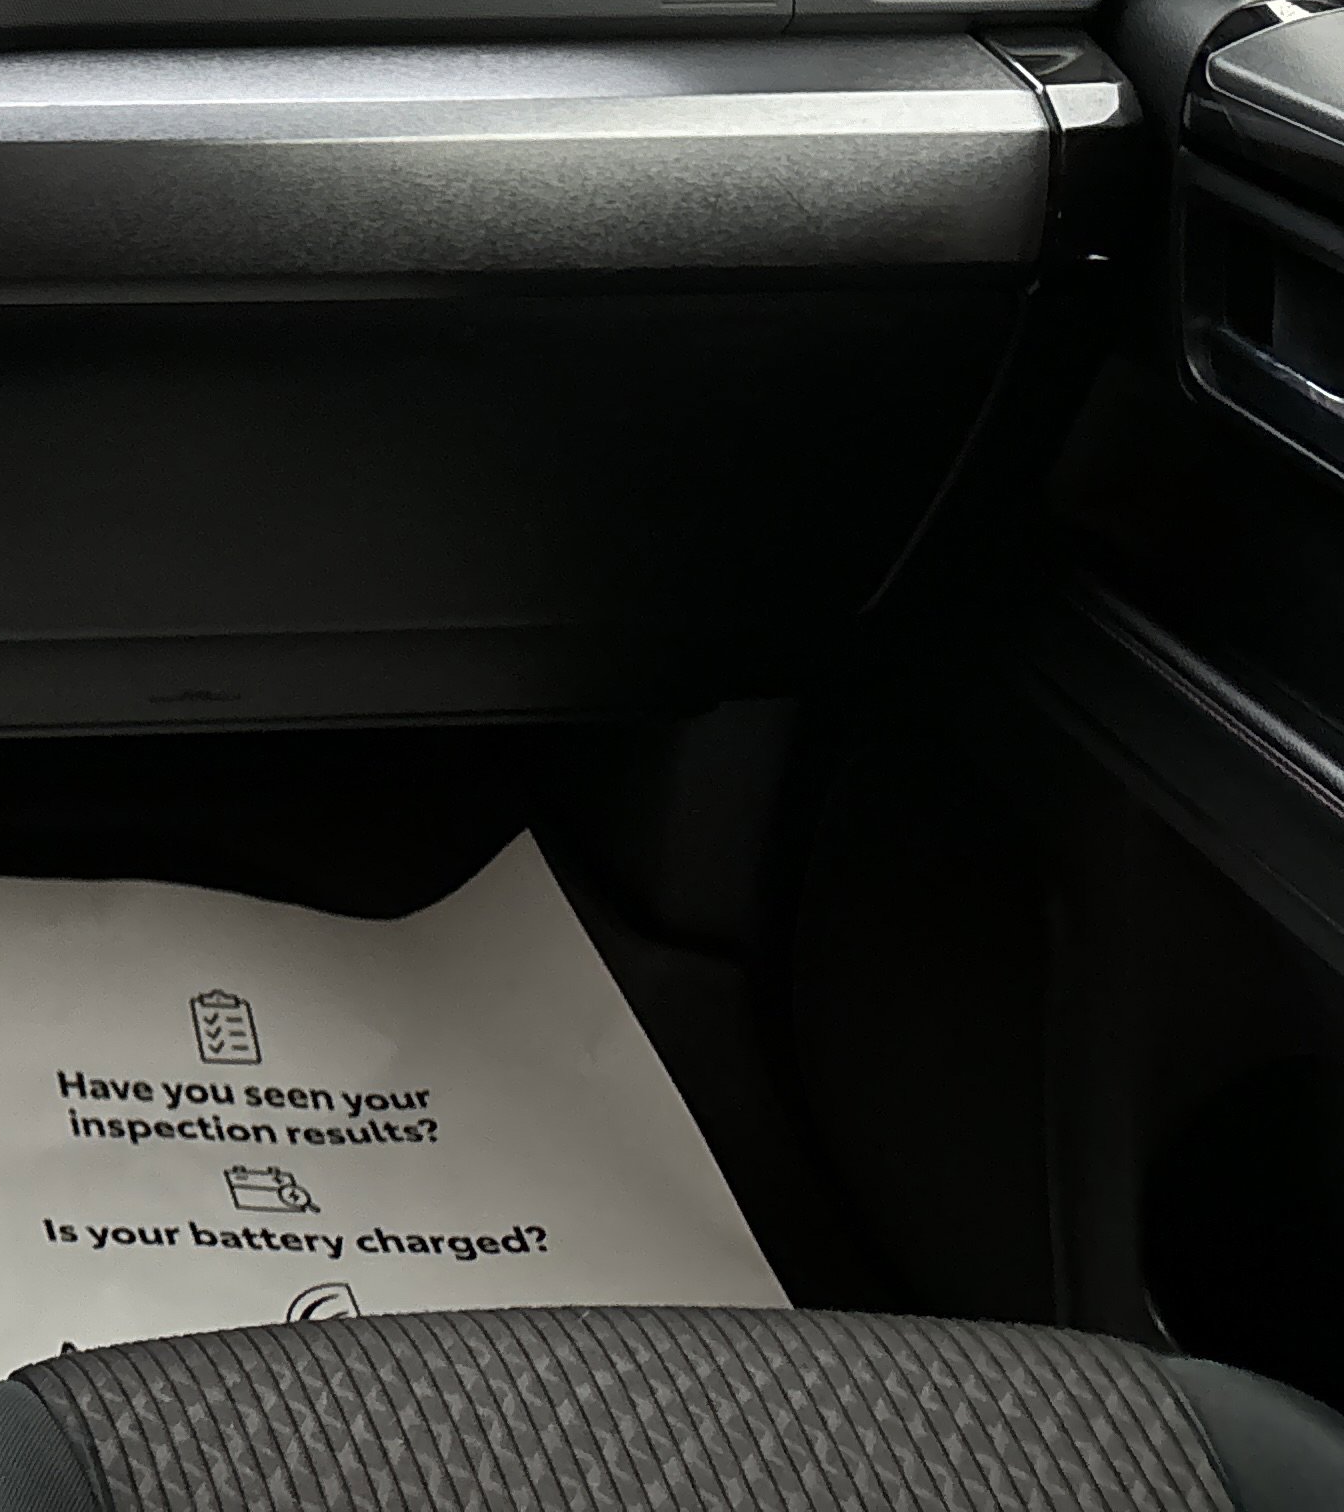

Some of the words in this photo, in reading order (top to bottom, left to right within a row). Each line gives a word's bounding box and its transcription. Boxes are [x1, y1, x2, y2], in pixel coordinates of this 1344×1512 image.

[56, 1069, 153, 1103] Have
[161, 1080, 235, 1110] you
[244, 1085, 334, 1112] seen
[341, 1088, 431, 1117] your
[69, 1108, 278, 1145] inspection
[287, 1118, 439, 1145] results?
[42, 1217, 79, 1245] Is
[85, 1222, 179, 1251] your
[188, 1220, 344, 1259] battery
[355, 1225, 549, 1261] charged?
